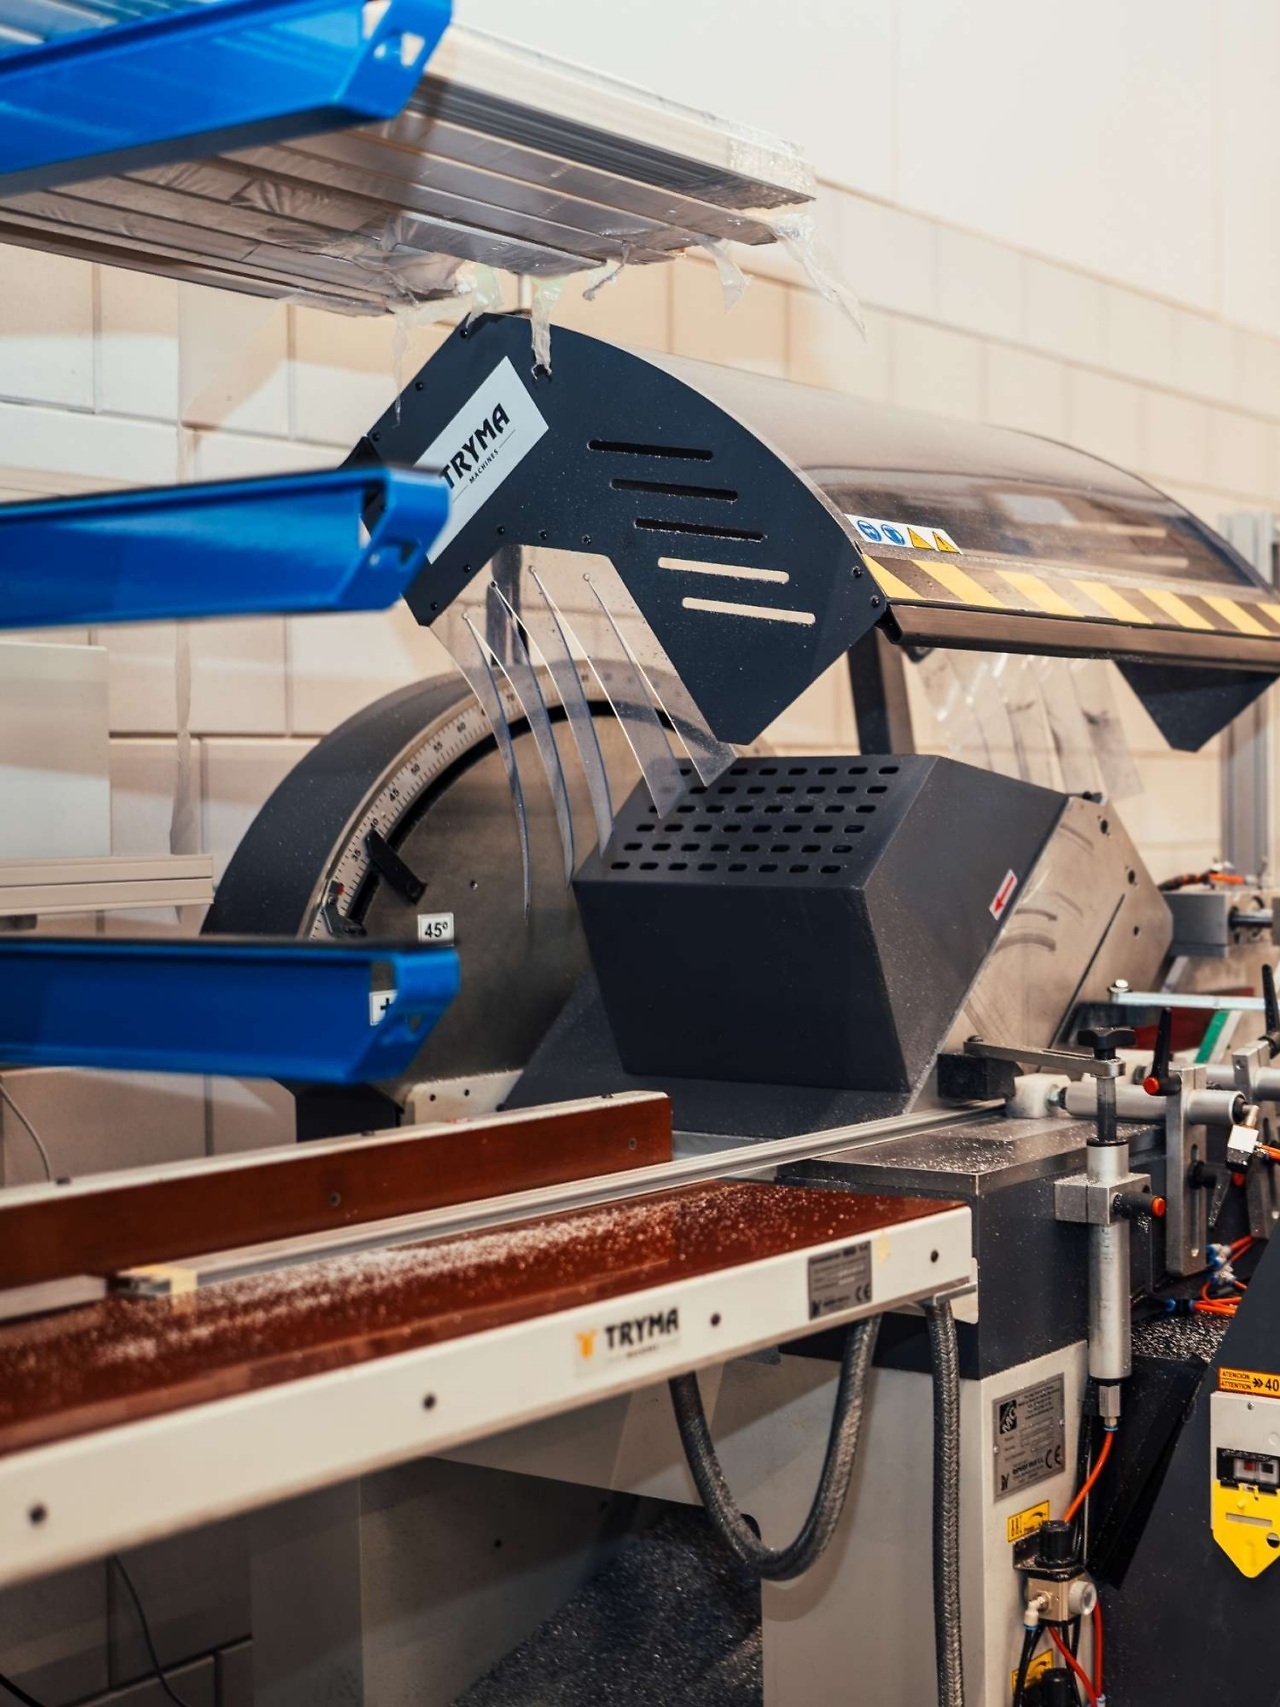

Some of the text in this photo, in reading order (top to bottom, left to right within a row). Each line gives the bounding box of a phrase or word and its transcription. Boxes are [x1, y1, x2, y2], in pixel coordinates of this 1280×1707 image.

[438, 403, 510, 488] TRYMA
[469, 449, 499, 484] MACHINES
[390, 788, 400, 802] 45
[424, 922, 449, 939] 45°
[603, 1307, 679, 1351] TRYMA
